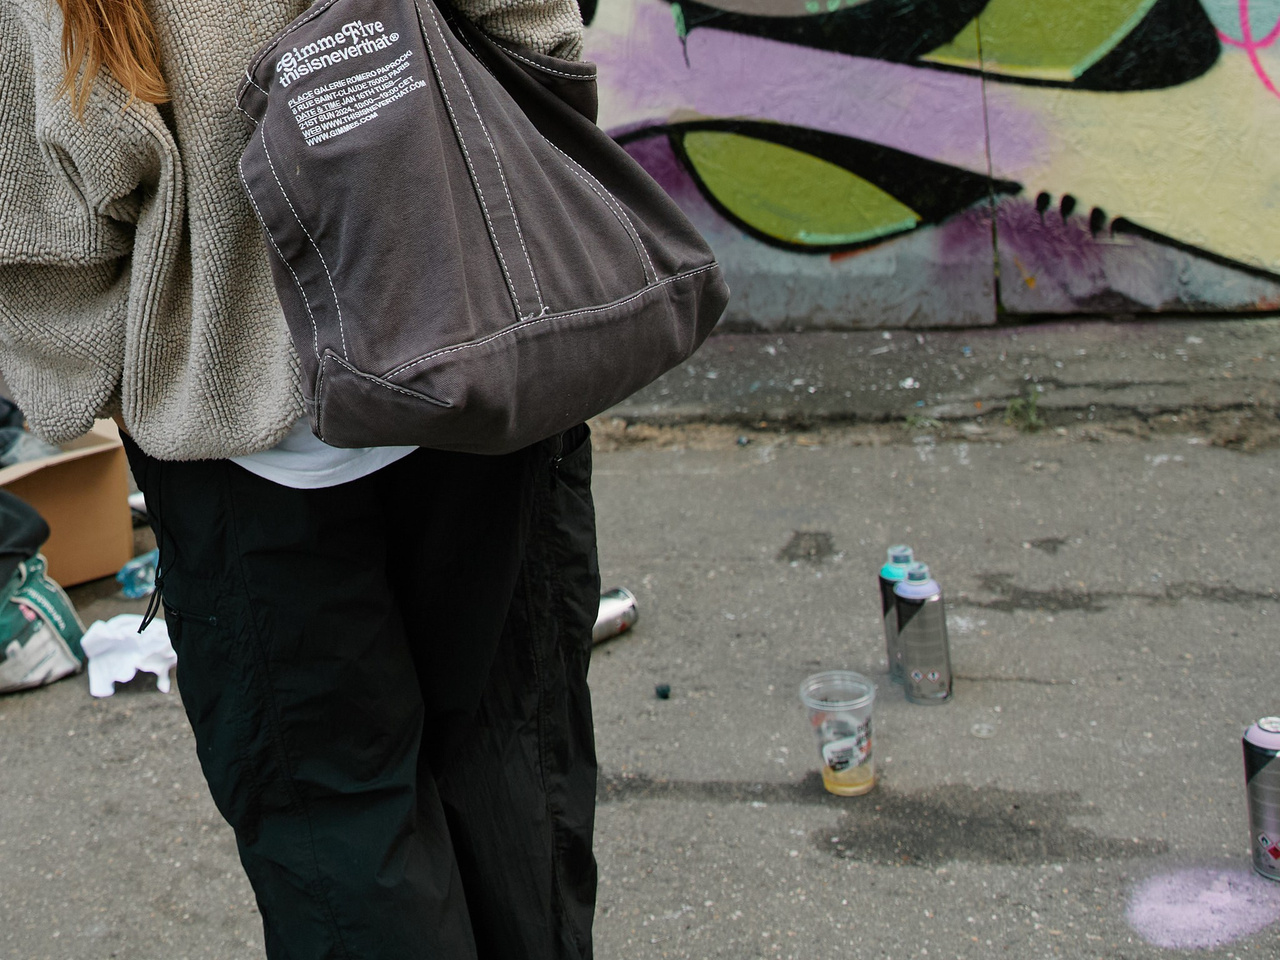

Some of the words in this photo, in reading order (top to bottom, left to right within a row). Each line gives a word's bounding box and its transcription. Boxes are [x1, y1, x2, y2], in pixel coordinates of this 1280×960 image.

[287, 90, 314, 107] PLACE
[314, 79, 346, 95] GALERIE
[346, 70, 377, 86] ROMERO
[376, 50, 413, 75] PAPROCKI
[295, 108, 317, 122] DATE
[322, 99, 341, 112] TIME
[341, 94, 356, 106] JAN
[356, 88, 375, 100] 16TH
[297, 99, 315, 112] RUE
[314, 83, 368, 106] SAINT-CLAUDE
[388, 61, 410, 79] PARIS
[299, 117, 318, 130] 21ST
[318, 111, 335, 122] SUN
[398, 75, 414, 89] CET
[302, 125, 322, 139] WEB
[320, 79, 427, 131] WWW.THISISNEVERTHAT.COM
